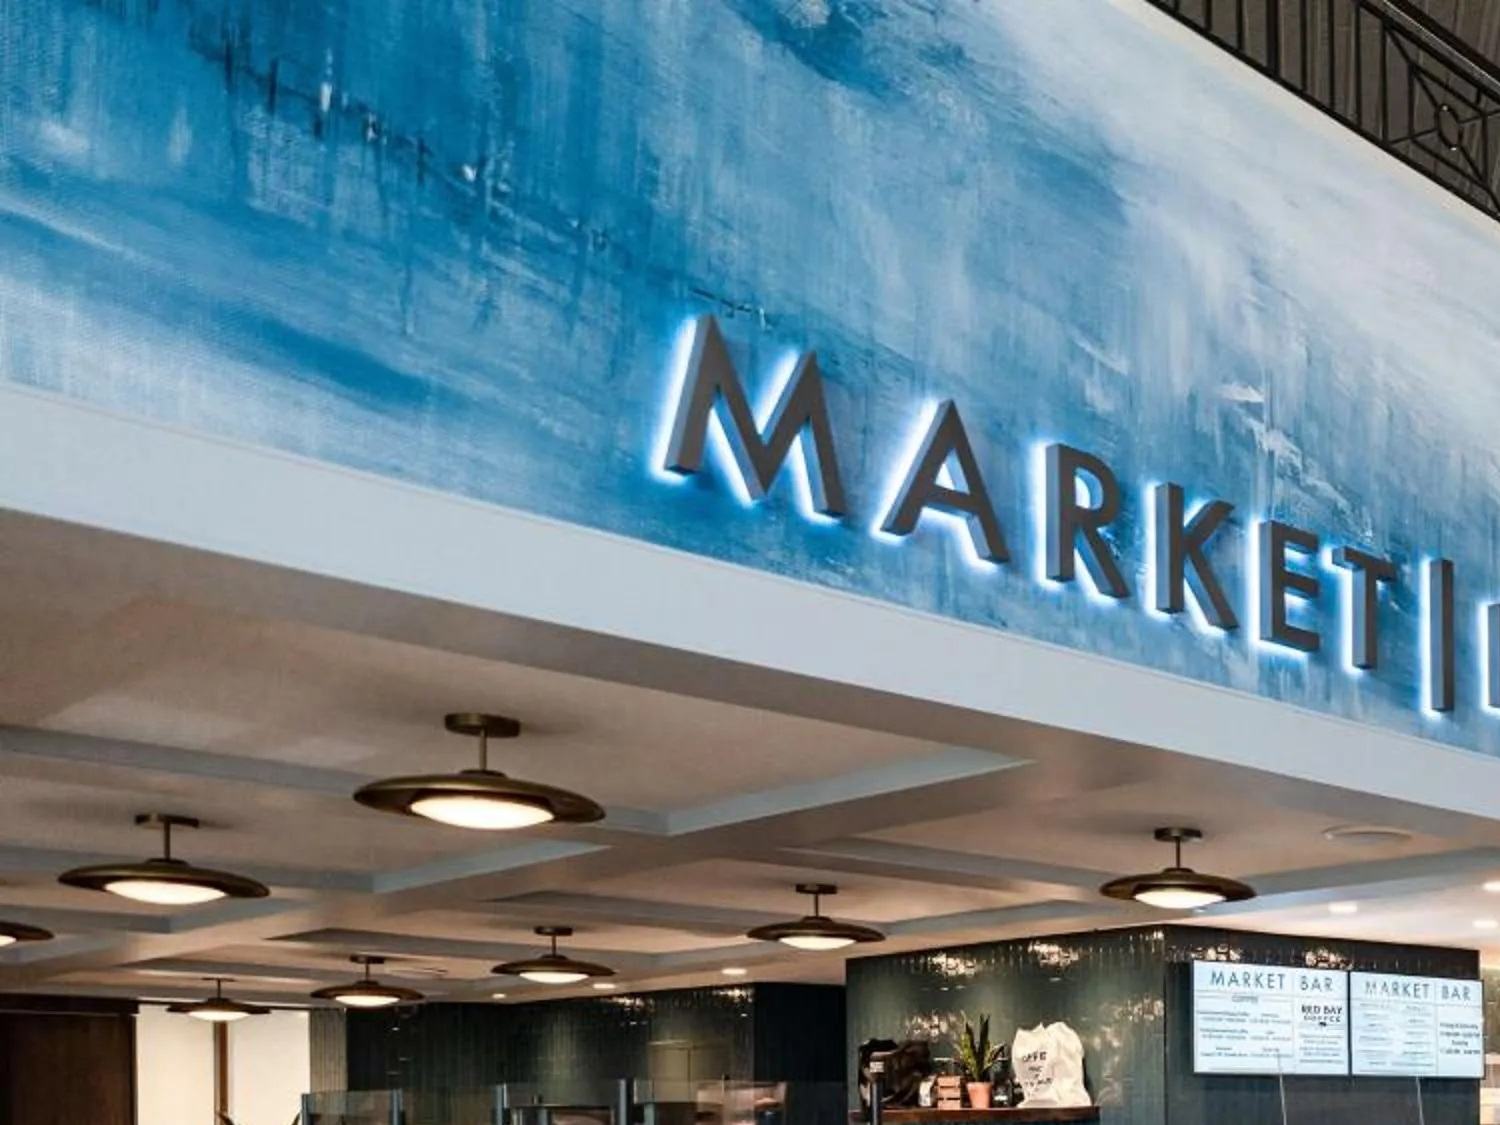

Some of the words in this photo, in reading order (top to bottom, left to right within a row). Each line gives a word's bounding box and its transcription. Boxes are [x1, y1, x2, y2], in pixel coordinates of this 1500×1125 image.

[664, 313, 1397, 670] MARKET
[1209, 969, 1286, 990] MARKET
[1299, 975, 1334, 992] BAR
[1364, 981, 1431, 999] MARKET
[1441, 985, 1472, 1001] BAR
[1301, 1003, 1321, 1015] RED
[1323, 1004, 1343, 1015] BAY
